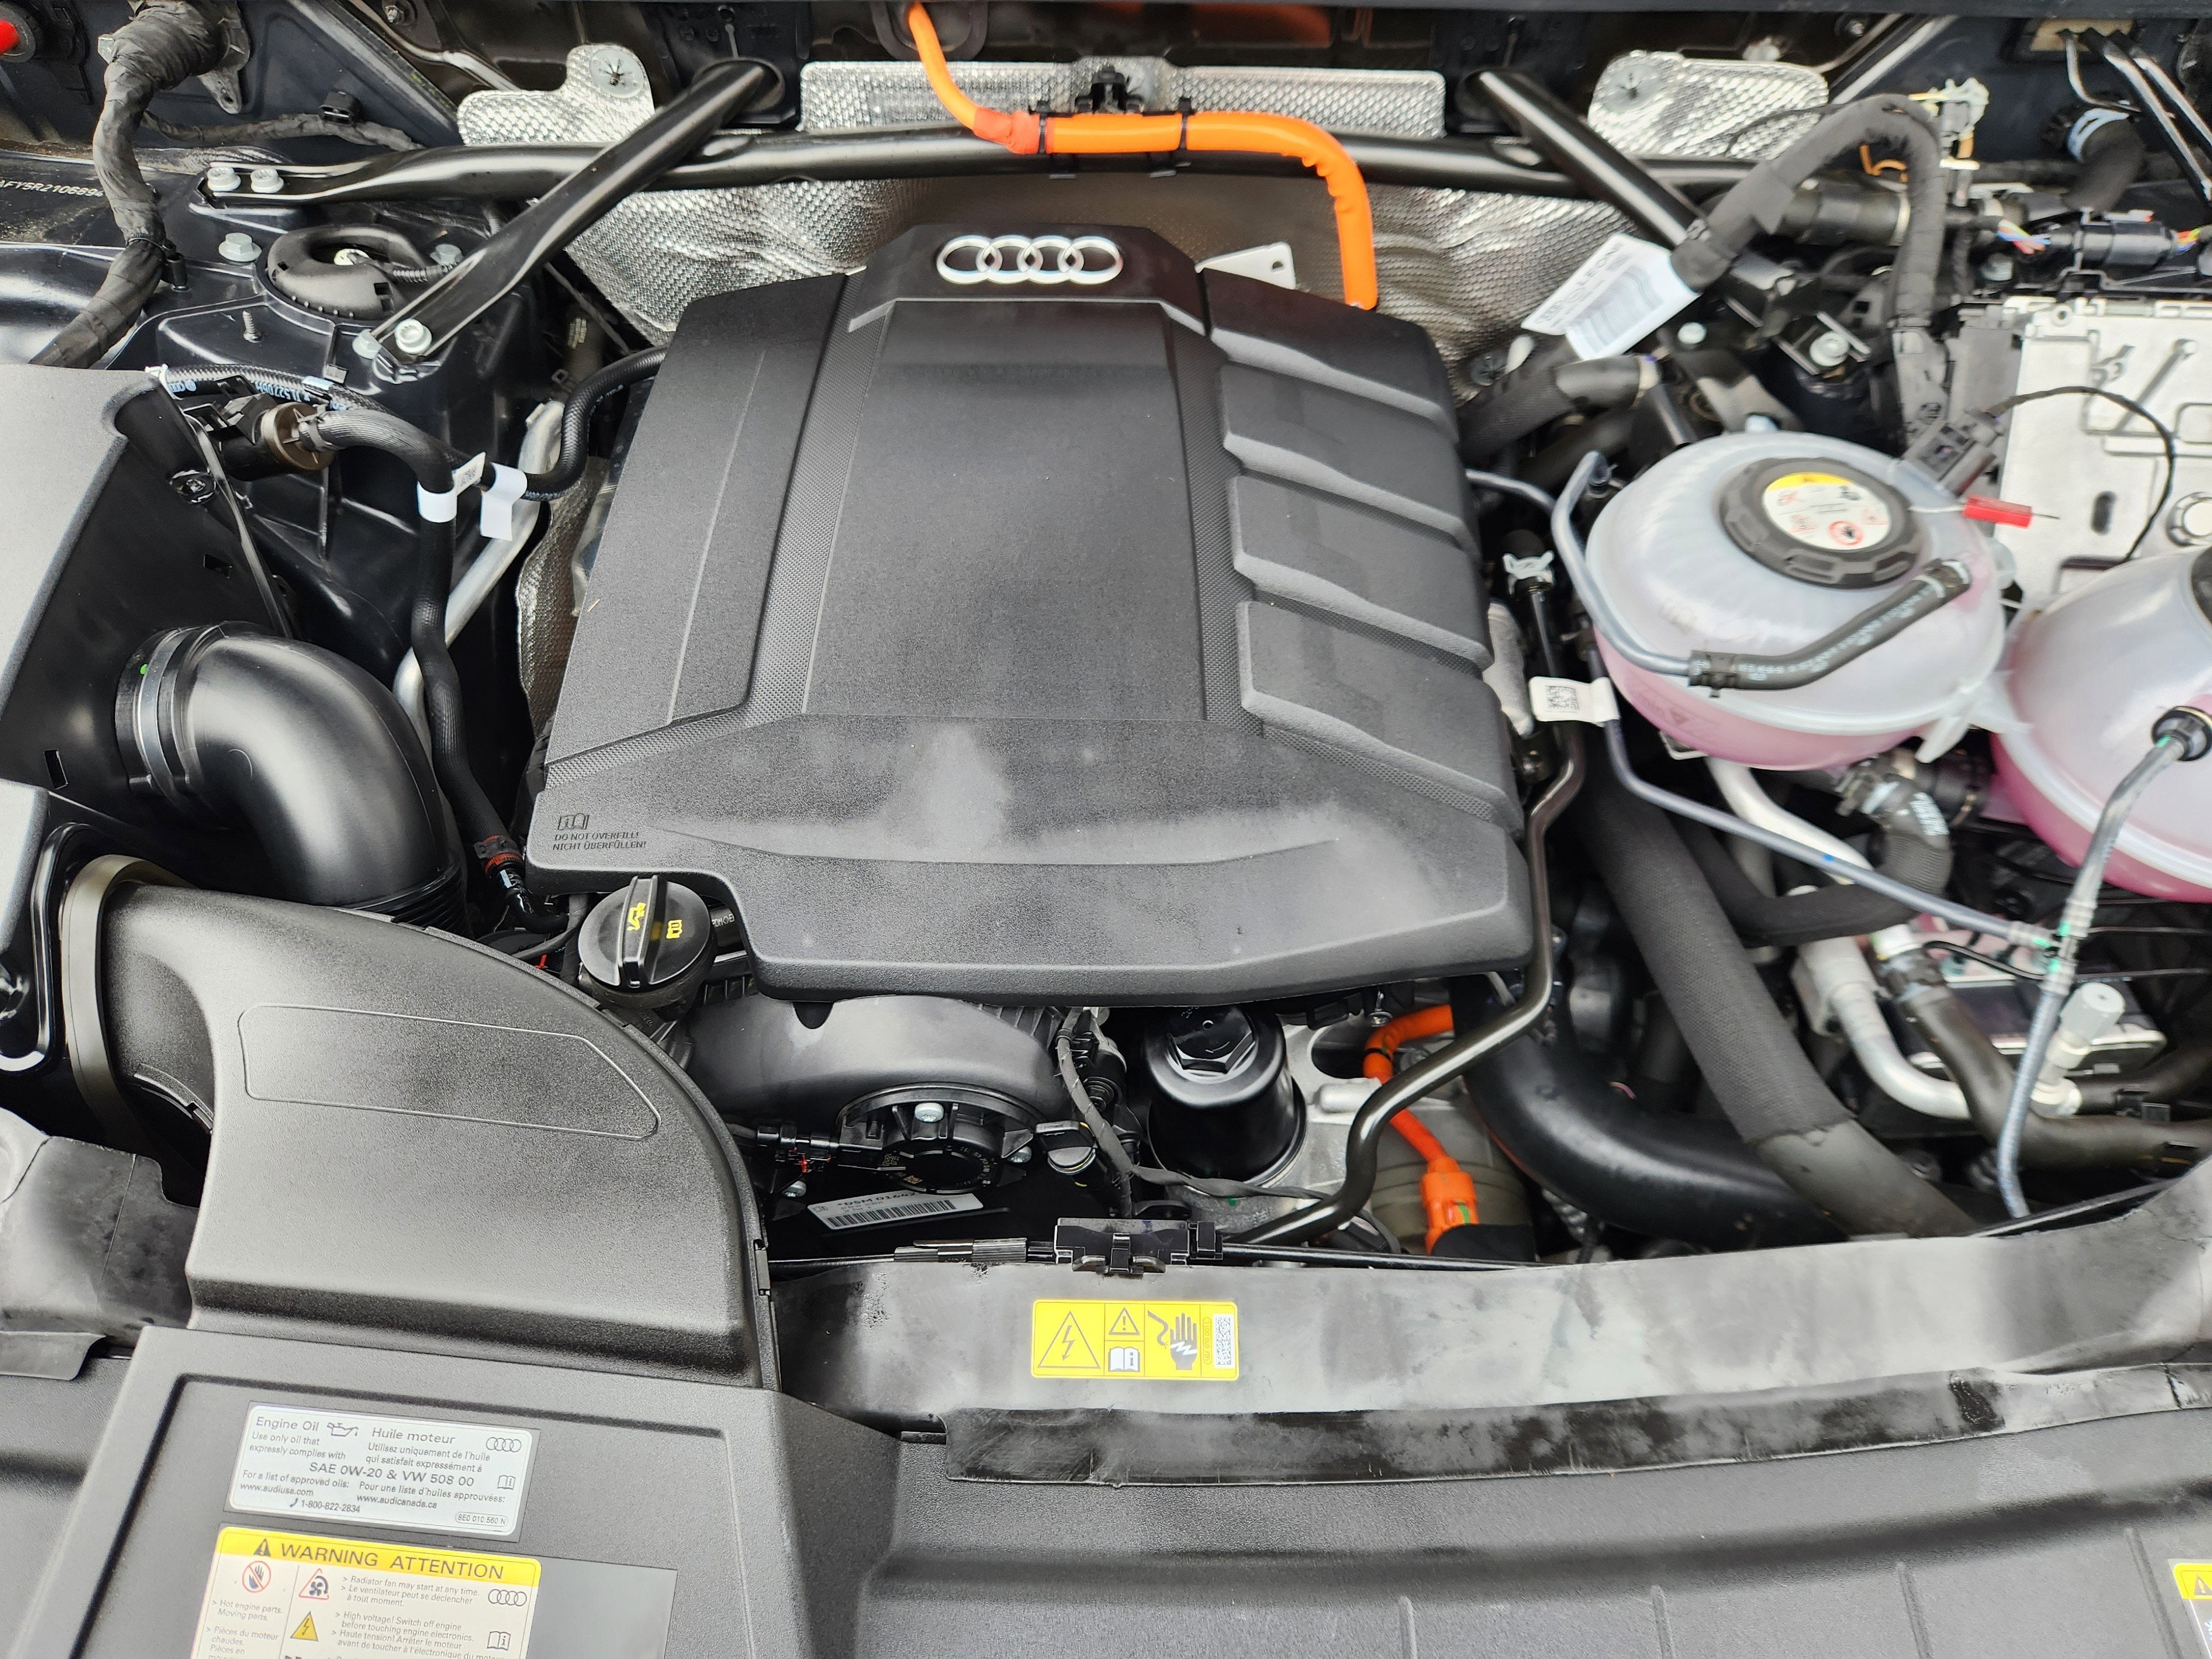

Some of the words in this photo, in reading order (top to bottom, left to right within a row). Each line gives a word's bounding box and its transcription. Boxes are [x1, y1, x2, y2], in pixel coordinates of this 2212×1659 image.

[592, 831, 639, 839] OVERFILL!
[584, 840, 646, 849] ÜBERFÜLLEN!
[256, 1416, 298, 1430] Engine
[302, 1421, 319, 1432] Oil
[252, 1431, 268, 1440] Use
[270, 1434, 288, 1444] only
[290, 1435, 301, 1444] oil
[304, 1437, 320, 1446] that
[372, 1427, 403, 1439] Huile
[407, 1433, 456, 1444] moteur
[249, 1444, 288, 1455] expressly
[289, 1448, 325, 1459] complies
[328, 1452, 346, 1460] with
[368, 1442, 397, 1453] Utilisez
[400, 1447, 450, 1459] uniquement
[452, 1450, 462, 1459] de
[366, 1455, 379, 1463] qui
[381, 1457, 414, 1467] satisfait
[416, 1461, 475, 1472] expressément
[243, 1470, 257, 1479] For
[265, 1472, 278, 1481] list
[280, 1473, 290, 1482] of
[291, 1476, 330, 1486] approved
[332, 1480, 349, 1488] oils:
[309, 1462, 337, 1474] SAE
[340, 1465, 383, 1478] 0W-20
[387, 1469, 397, 1480] &
[402, 1470, 426, 1482] VW
[430, 1474, 453, 1485] 508
[458, 1477, 474, 1486] 00
[240, 1483, 314, 1496] www.audiusa.com
[359, 1481, 379, 1491] Pour
[399, 1485, 415, 1494] liste
[454, 1493, 505, 1503] approuvées:
[301, 1500, 361, 1513] 1-800-822-2834
[357, 1495, 437, 1509] www.audicanada.ca
[281, 1542, 379, 1566] WARNING
[390, 1556, 504, 1580] ATTENTION
[351, 1575, 383, 1585] Radiator
[384, 1579, 397, 1588] fan
[445, 1587, 459, 1595] any
[461, 1587, 479, 1596] time.
[360, 1587, 400, 1597] ventilateur
[431, 1593, 473, 1604] déclencher
[371, 1597, 404, 1607] moment.
[218, 1608, 246, 1620] Moving
[248, 1613, 269, 1621] parts.
[220, 1599, 233, 1608] Hot
[236, 1603, 260, 1612] engine
[262, 1605, 283, 1614] parts.
[343, 1611, 361, 1621] High
[363, 1614, 394, 1624] voltage!
[396, 1617, 421, 1627] Switch
[435, 1622, 462, 1631] engine
[213, 1625, 237, 1636] Pièces
[251, 1632, 279, 1641] moteur
[340, 1629, 362, 1639] Haute
[364, 1632, 395, 1642] tension!
[396, 1636, 424, 1645] Arrêter
[434, 1640, 462, 1649] moteur
[341, 1621, 366, 1630] before
[368, 1625, 401, 1635] touching
[403, 1628, 429, 1637] engine
[431, 1630, 474, 1642] electronics.
[212, 1635, 244, 1646] chaudes.
[337, 1639, 359, 1648] avant
[361, 1641, 371, 1650] de
[372, 1643, 401, 1652] toucher
[210, 1644, 233, 1654] Pièces
